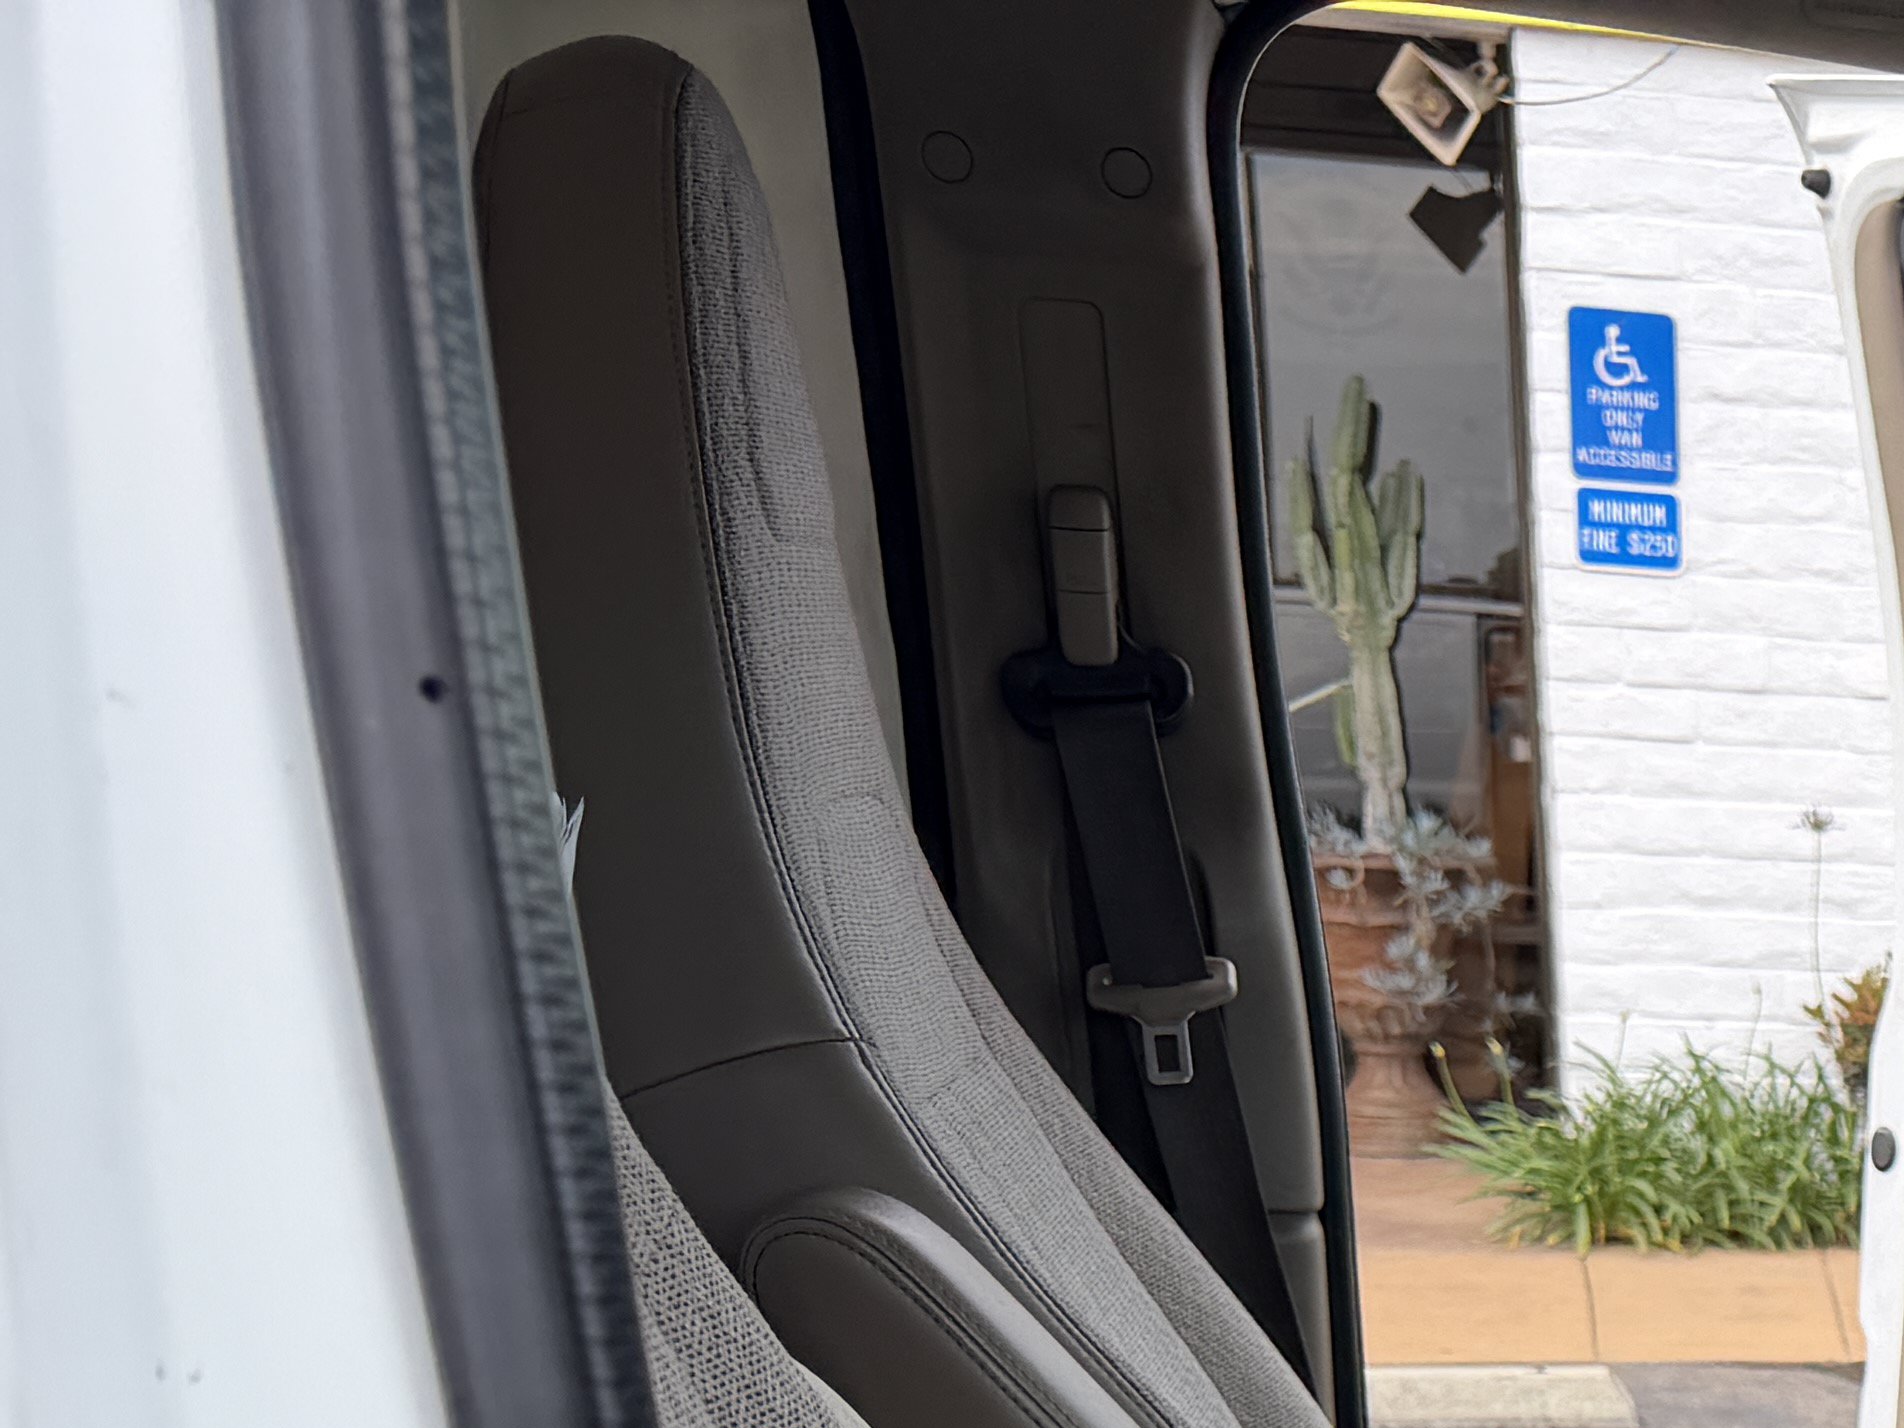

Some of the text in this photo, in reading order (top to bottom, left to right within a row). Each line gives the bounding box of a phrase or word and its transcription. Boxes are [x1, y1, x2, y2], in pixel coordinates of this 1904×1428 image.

[1587, 387, 1660, 411] PARKING
[1601, 409, 1645, 429] ONLY
[1606, 430, 1643, 449] VAN
[1576, 446, 1675, 472] ACCESSIBLE
[1588, 499, 1667, 528] MINIMUM
[1581, 528, 1620, 554] FINE
